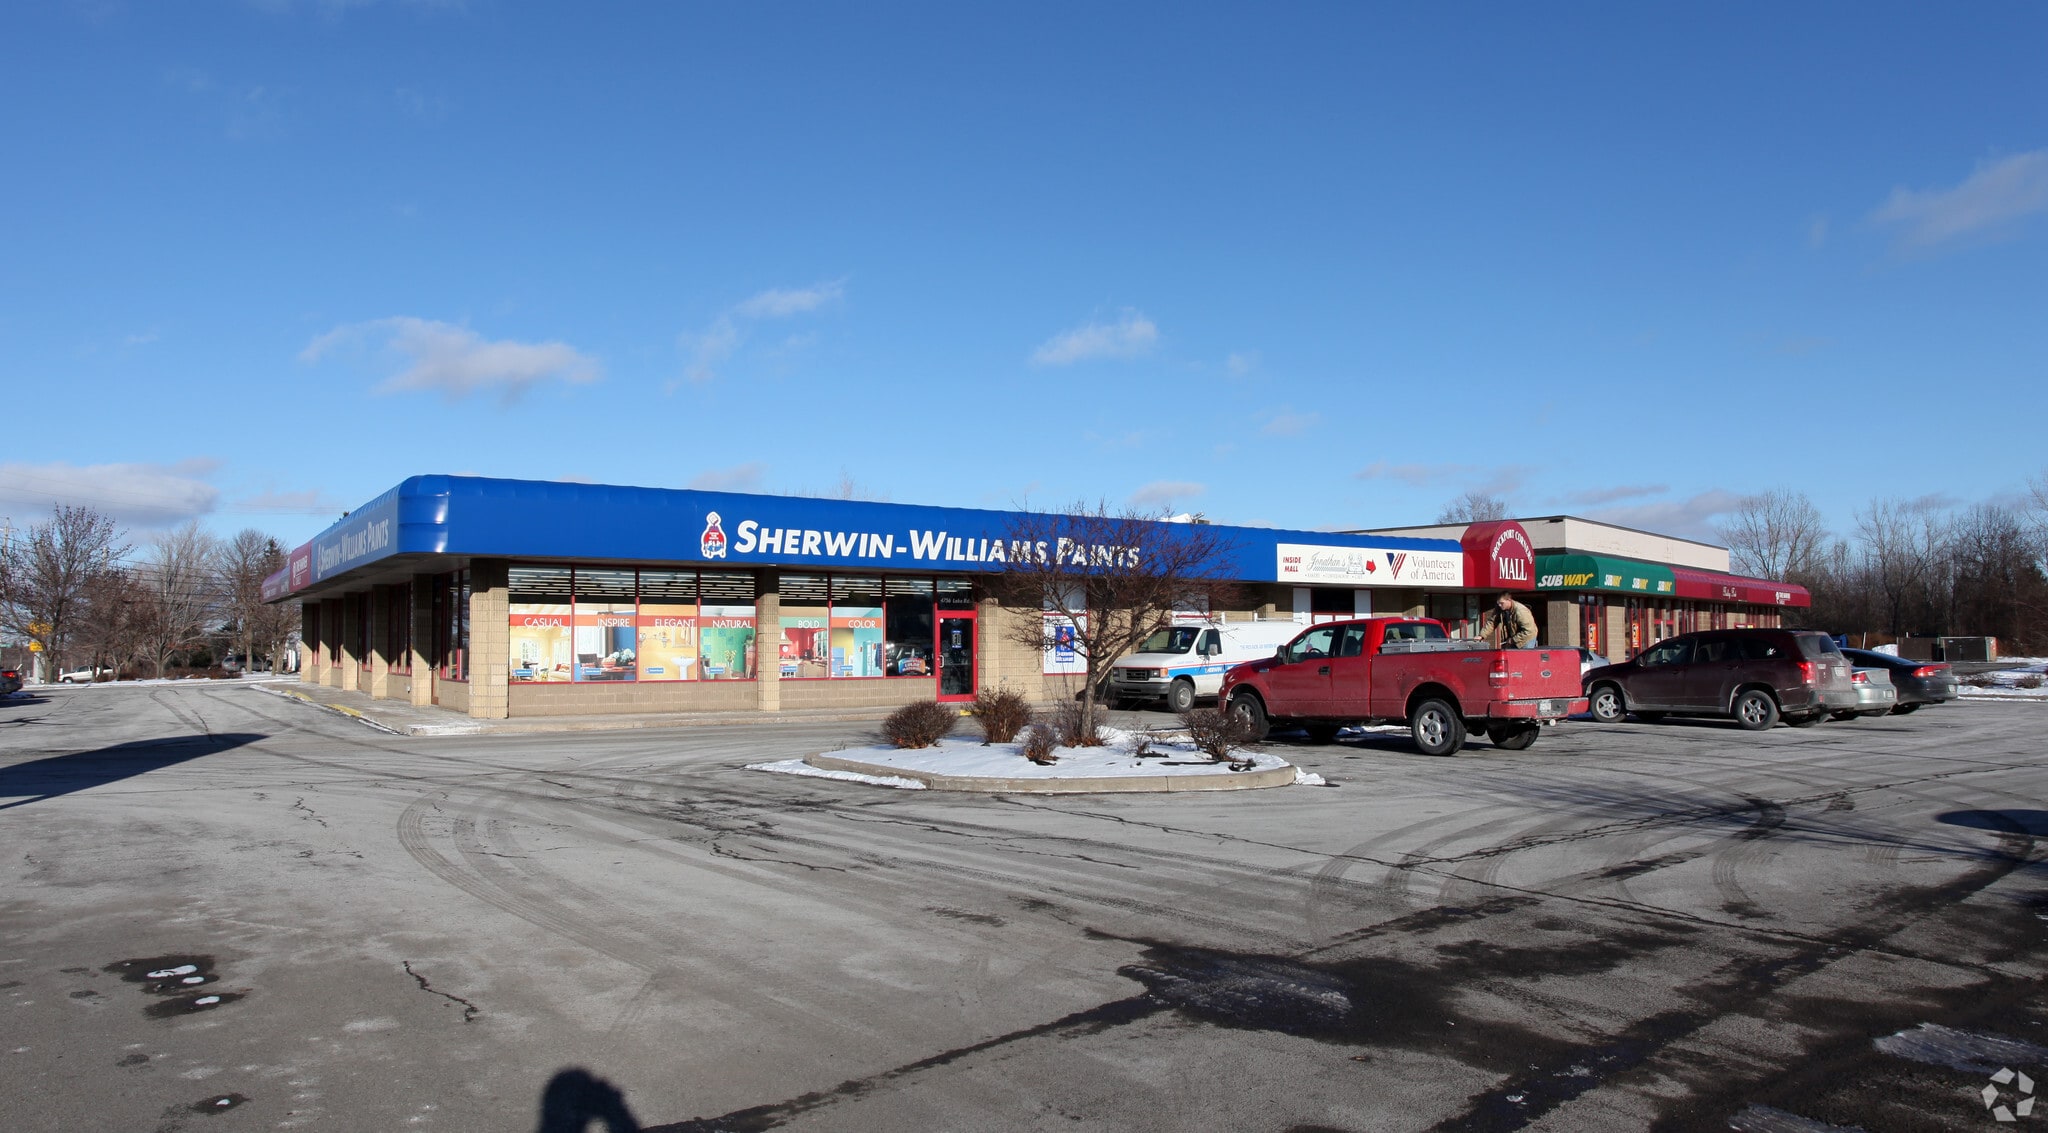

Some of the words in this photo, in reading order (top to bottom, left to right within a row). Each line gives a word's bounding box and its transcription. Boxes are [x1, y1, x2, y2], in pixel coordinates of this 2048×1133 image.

[734, 519, 1048, 565] SHERWIN-WILLIAMS
[1056, 537, 1140, 568] PAINTS
[1282, 556, 1302, 564] INSIDE
[1411, 556, 1455, 569] Volunteers
[1284, 565, 1299, 573] MALL
[1499, 556, 1528, 581] MALL
[1410, 568, 1419, 580] of
[1421, 569, 1456, 581] America
[1537, 572, 1594, 588] SUBWAY
[524, 617, 565, 628] CASUAL
[597, 618, 630, 628] INSPIRE
[654, 618, 696, 628] ELEGANT
[712, 619, 753, 629] NATURAL
[798, 619, 820, 629] BOLD
[848, 619, 876, 629] COLOR
